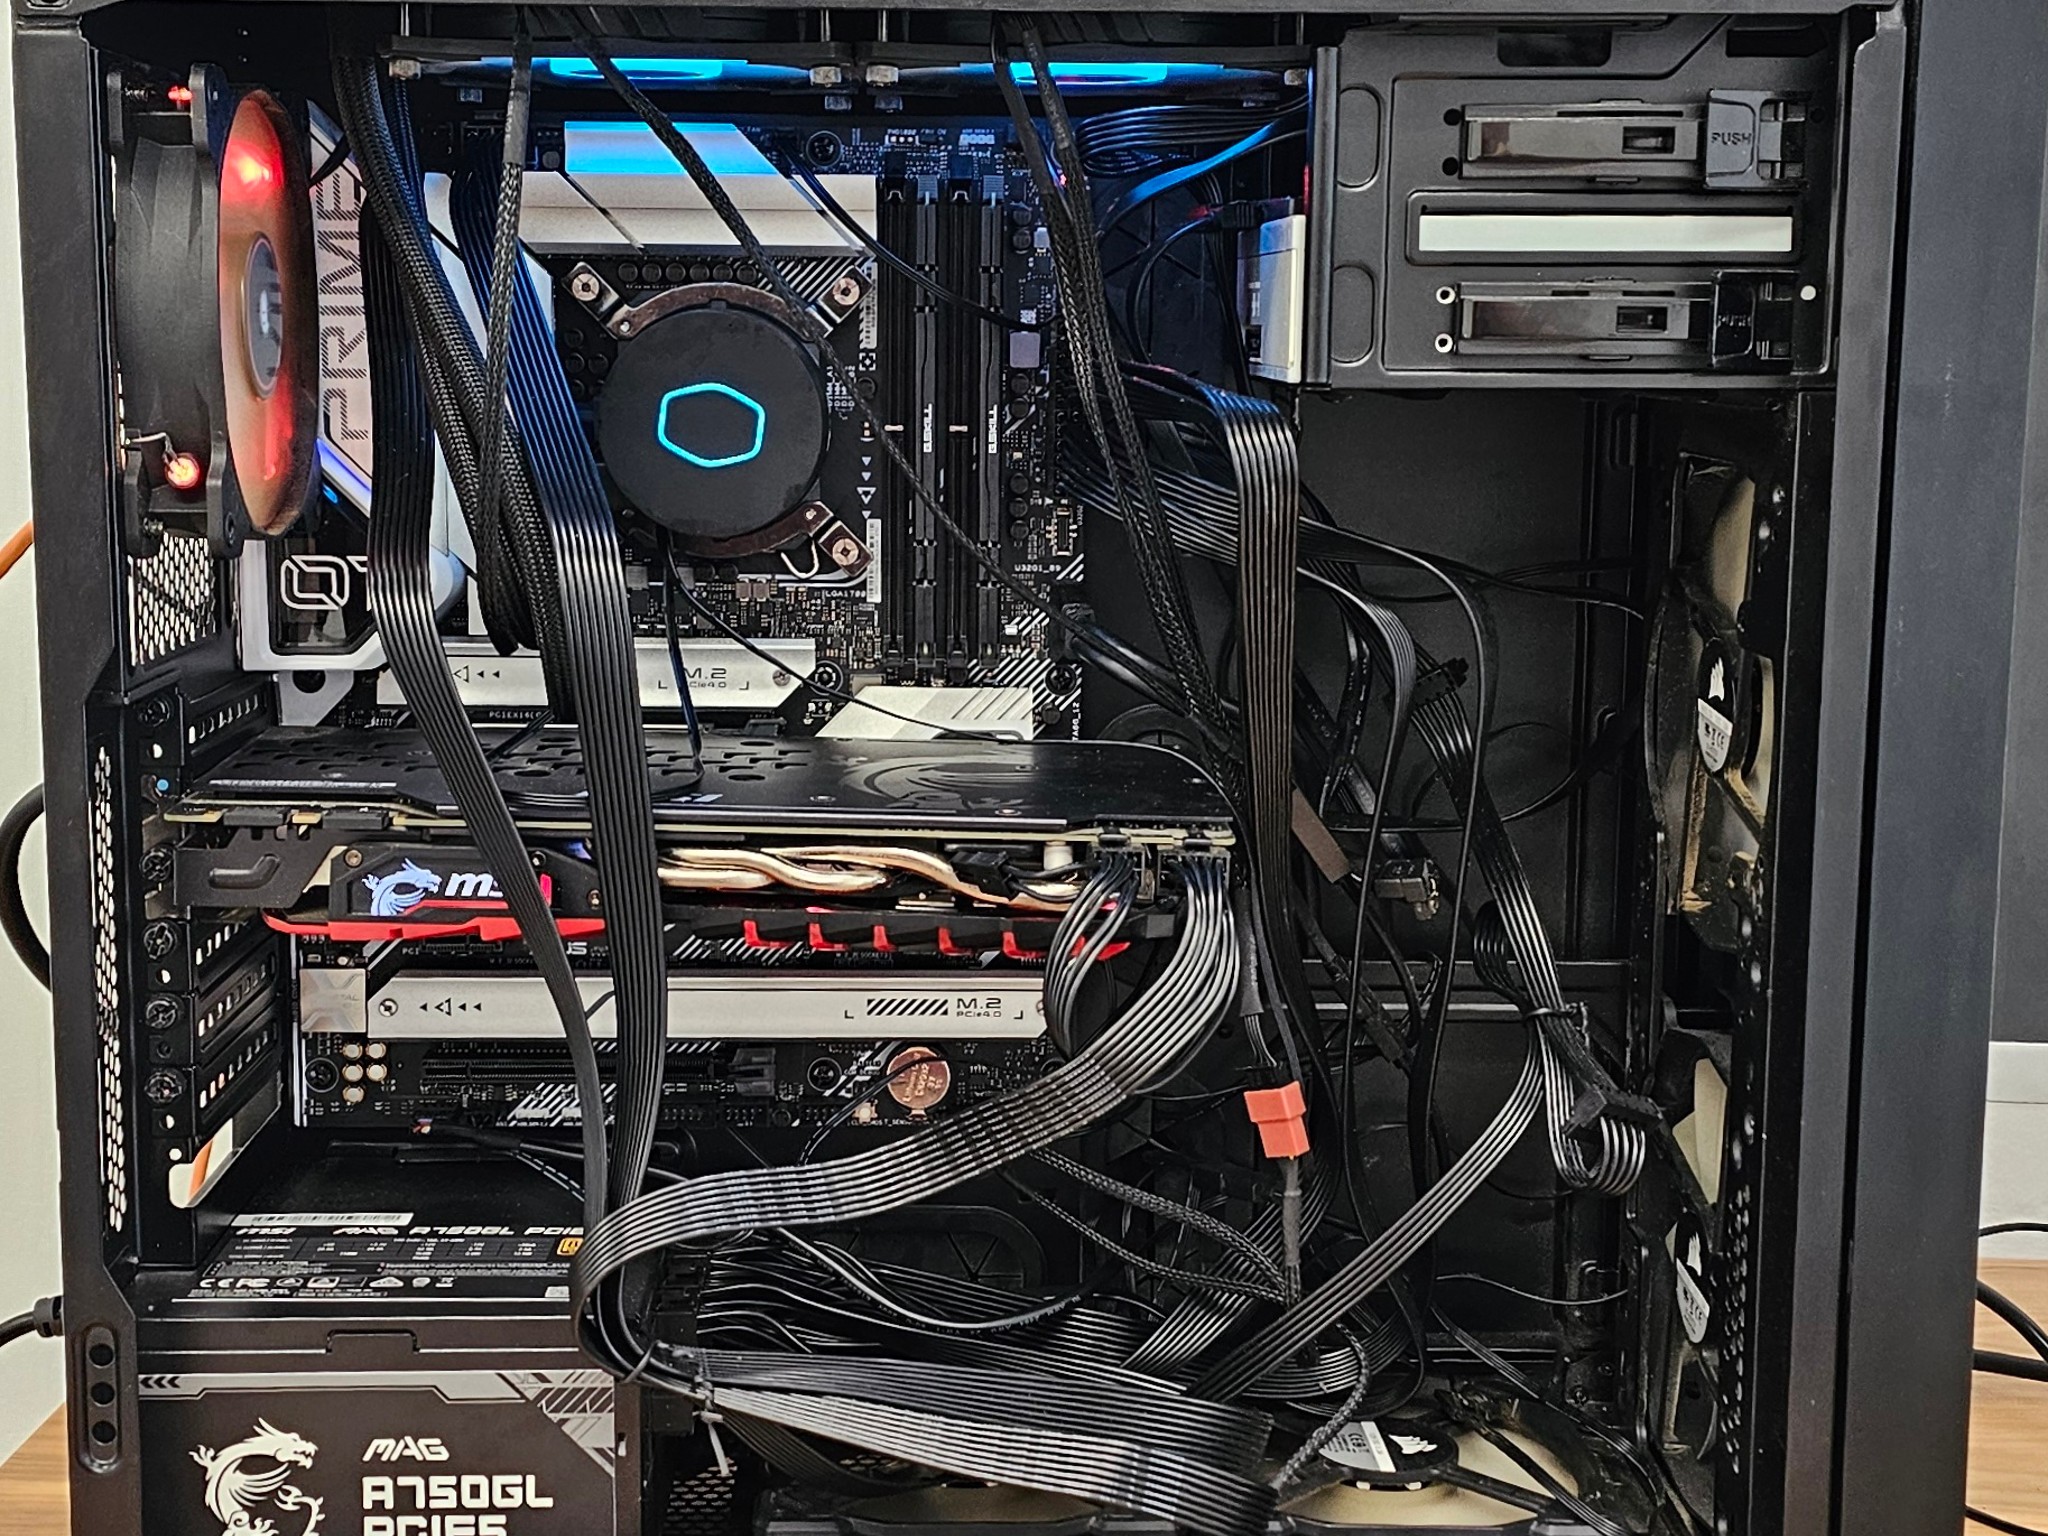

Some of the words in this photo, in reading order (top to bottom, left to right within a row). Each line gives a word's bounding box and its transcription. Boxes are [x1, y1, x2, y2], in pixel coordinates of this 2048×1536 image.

[1711, 132, 1752, 146] PUSH
[316, 170, 370, 441] PRIME
[684, 667, 727, 680] M.2
[956, 997, 1002, 1010] M.2
[523, 1226, 584, 1236] PCIE
[362, 1435, 450, 1462] MAG
[362, 1474, 554, 1510] A750GL
